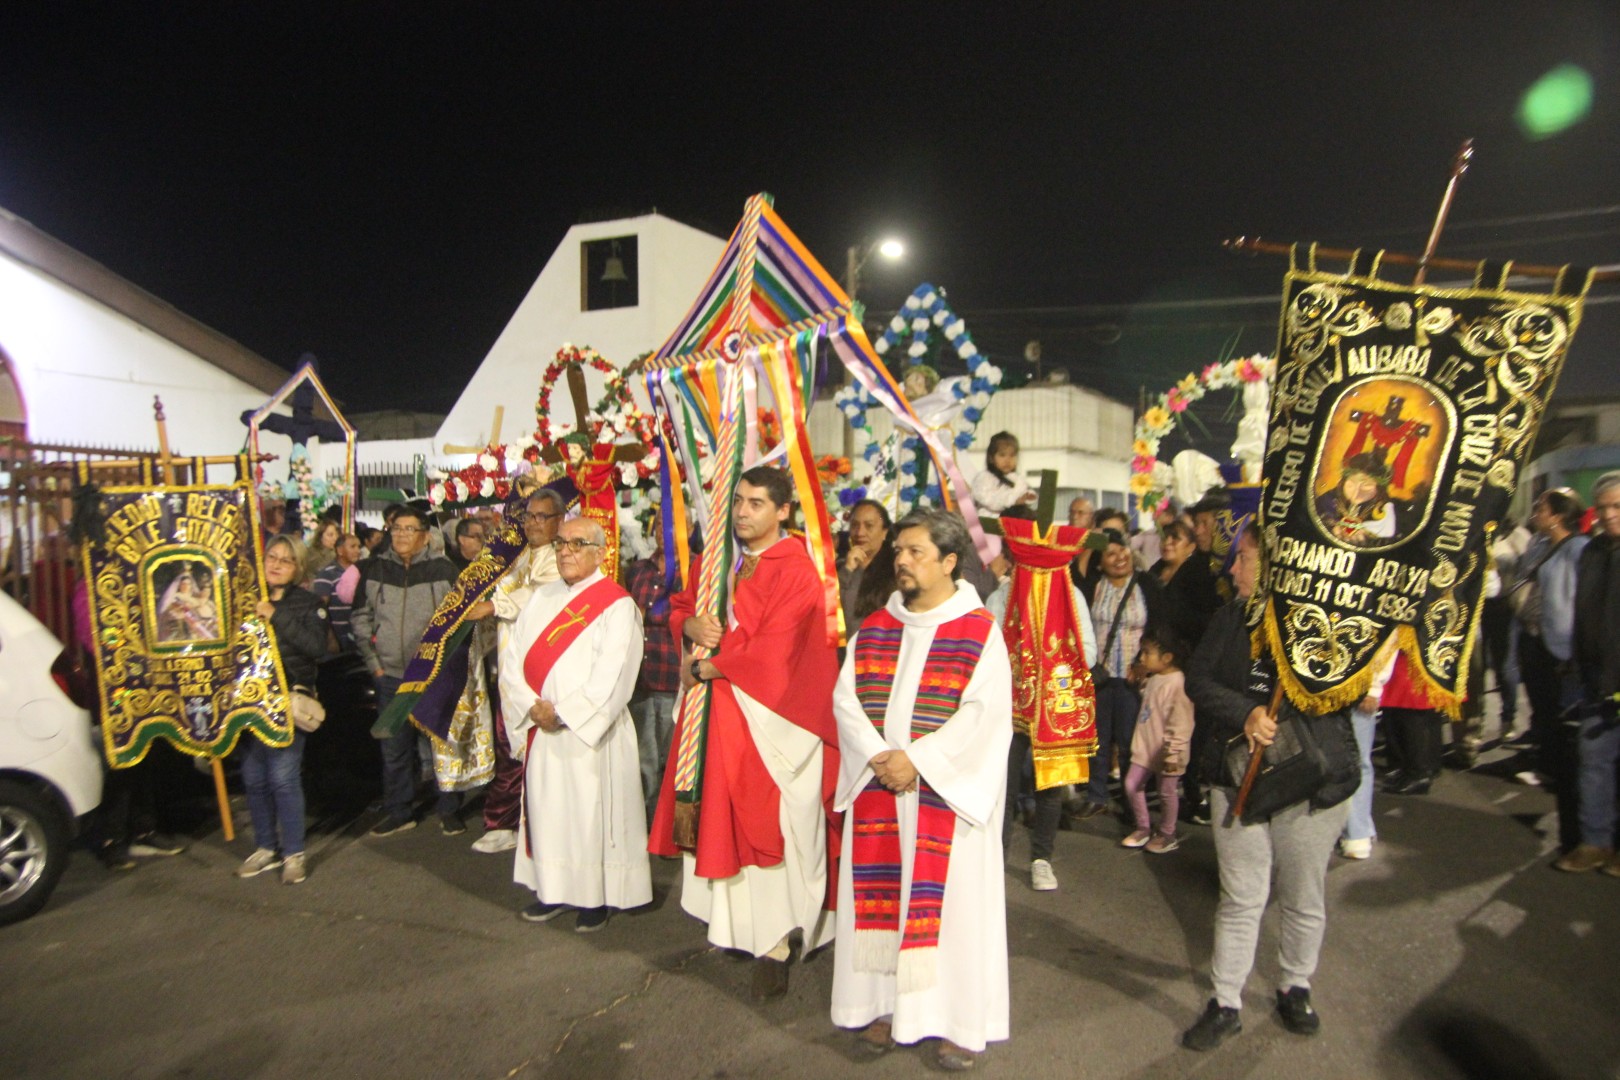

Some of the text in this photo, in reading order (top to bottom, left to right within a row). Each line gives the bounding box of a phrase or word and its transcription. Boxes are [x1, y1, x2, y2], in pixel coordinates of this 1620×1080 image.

[1432, 354, 1475, 391] DE
[1457, 379, 1489, 413] LA
[1289, 418, 1315, 445] DE
[1457, 413, 1498, 467] CRUZ
[1450, 468, 1487, 499] DE
[1366, 557, 1430, 599] ARAYA
[1313, 577, 1333, 603] 11
[1376, 592, 1421, 622] 1986
